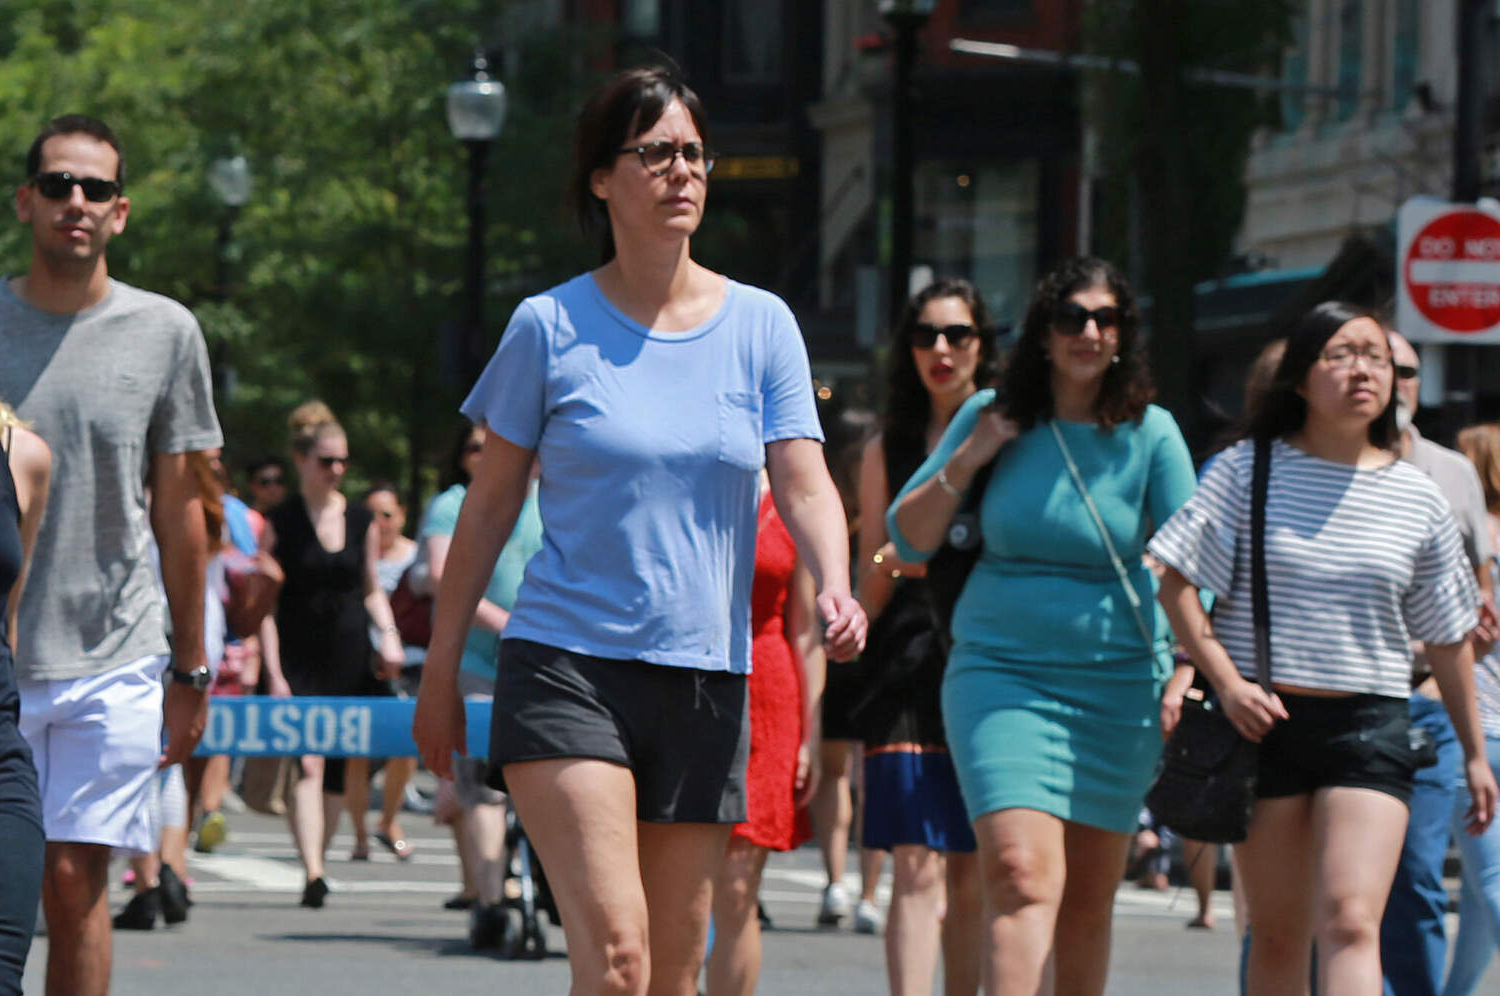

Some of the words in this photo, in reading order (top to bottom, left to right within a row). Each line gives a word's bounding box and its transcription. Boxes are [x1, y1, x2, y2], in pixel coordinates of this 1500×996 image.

[1420, 236, 1457, 260] DO
[1465, 238, 1500, 261] NO
[1428, 285, 1500, 308] ENTER
[203, 704, 371, 754] BOSTO
